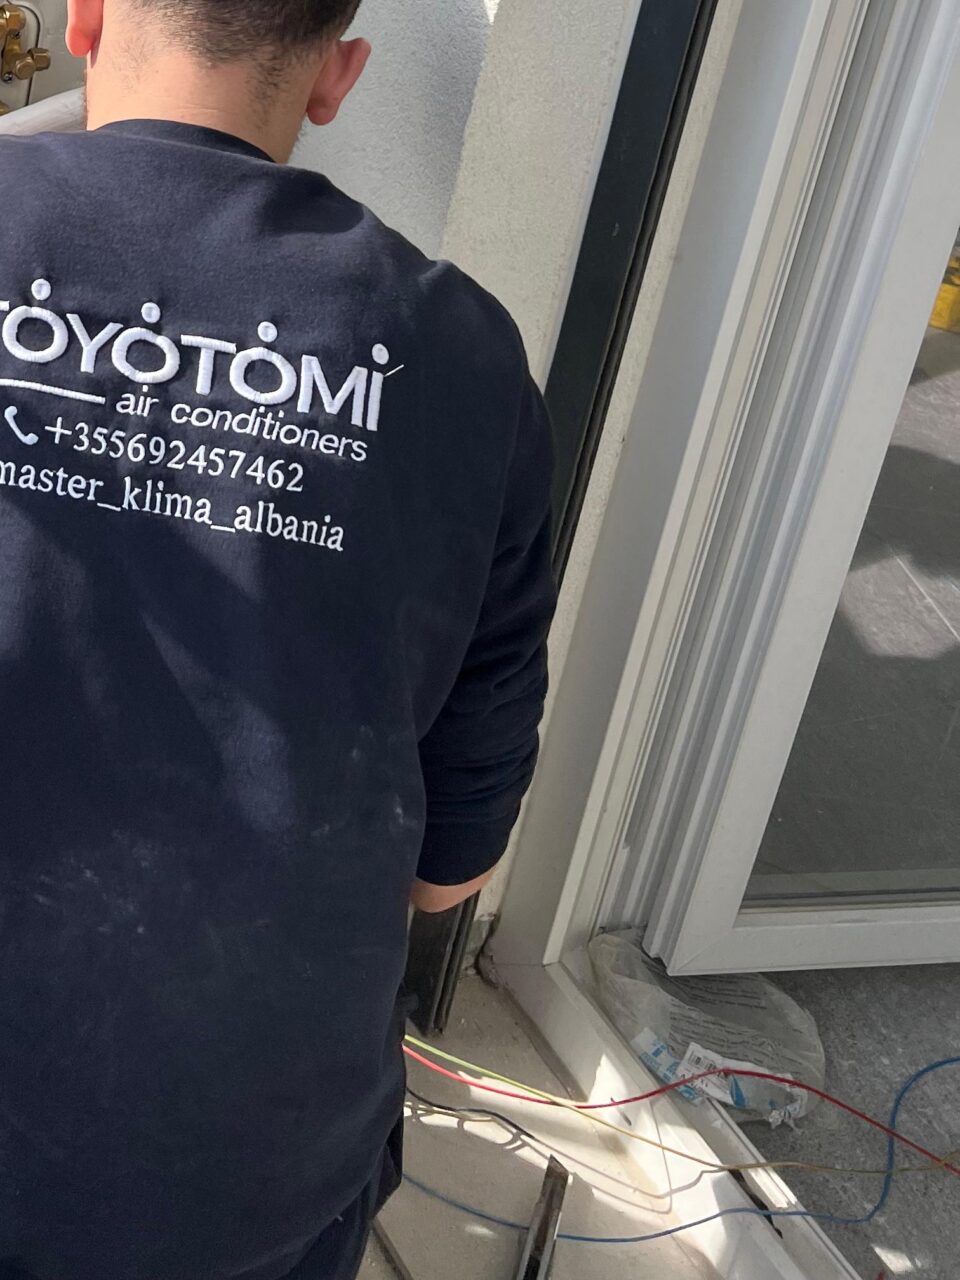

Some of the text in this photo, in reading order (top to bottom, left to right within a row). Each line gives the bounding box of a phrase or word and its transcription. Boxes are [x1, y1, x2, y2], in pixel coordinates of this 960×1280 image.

[115, 384, 159, 418] air
[170, 401, 368, 462] conditioners
[45, 416, 304, 492] +355692457462
